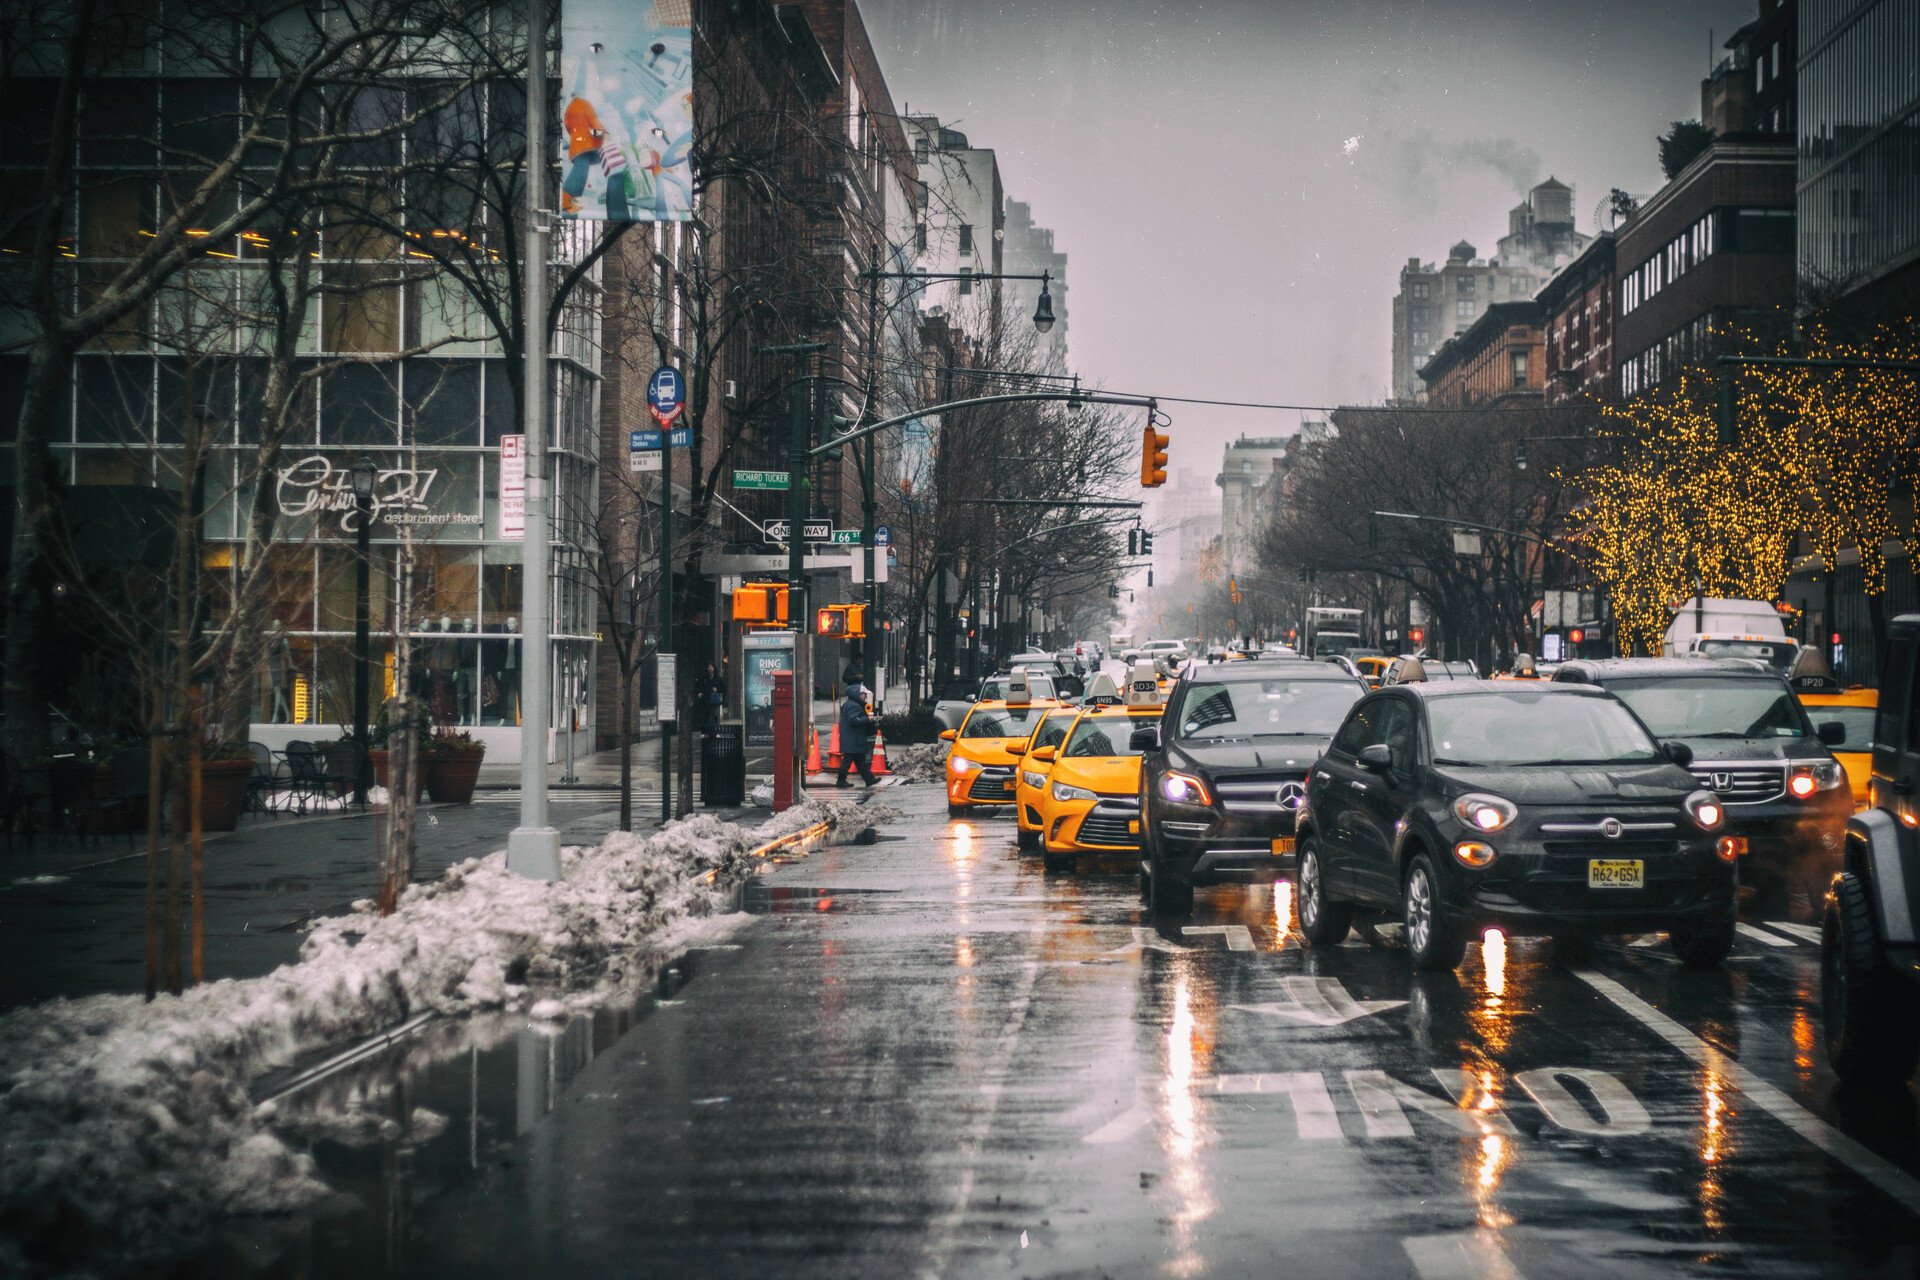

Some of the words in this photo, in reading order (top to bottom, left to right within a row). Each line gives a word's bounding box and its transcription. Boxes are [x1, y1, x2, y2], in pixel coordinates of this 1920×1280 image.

[671, 431, 686, 444] M11
[736, 472, 763, 482] RICHARD
[764, 473, 789, 483] TUCKER
[379, 469, 437, 505] 21
[451, 512, 479, 523] store
[773, 527, 791, 536] ONE
[804, 526, 826, 536] WAY
[838, 532, 850, 542] 66
[758, 637, 781, 645] TITAN
[759, 658, 781, 669] RING
[1134, 682, 1155, 691] 3D34
[1801, 678, 1824, 687] 8P20
